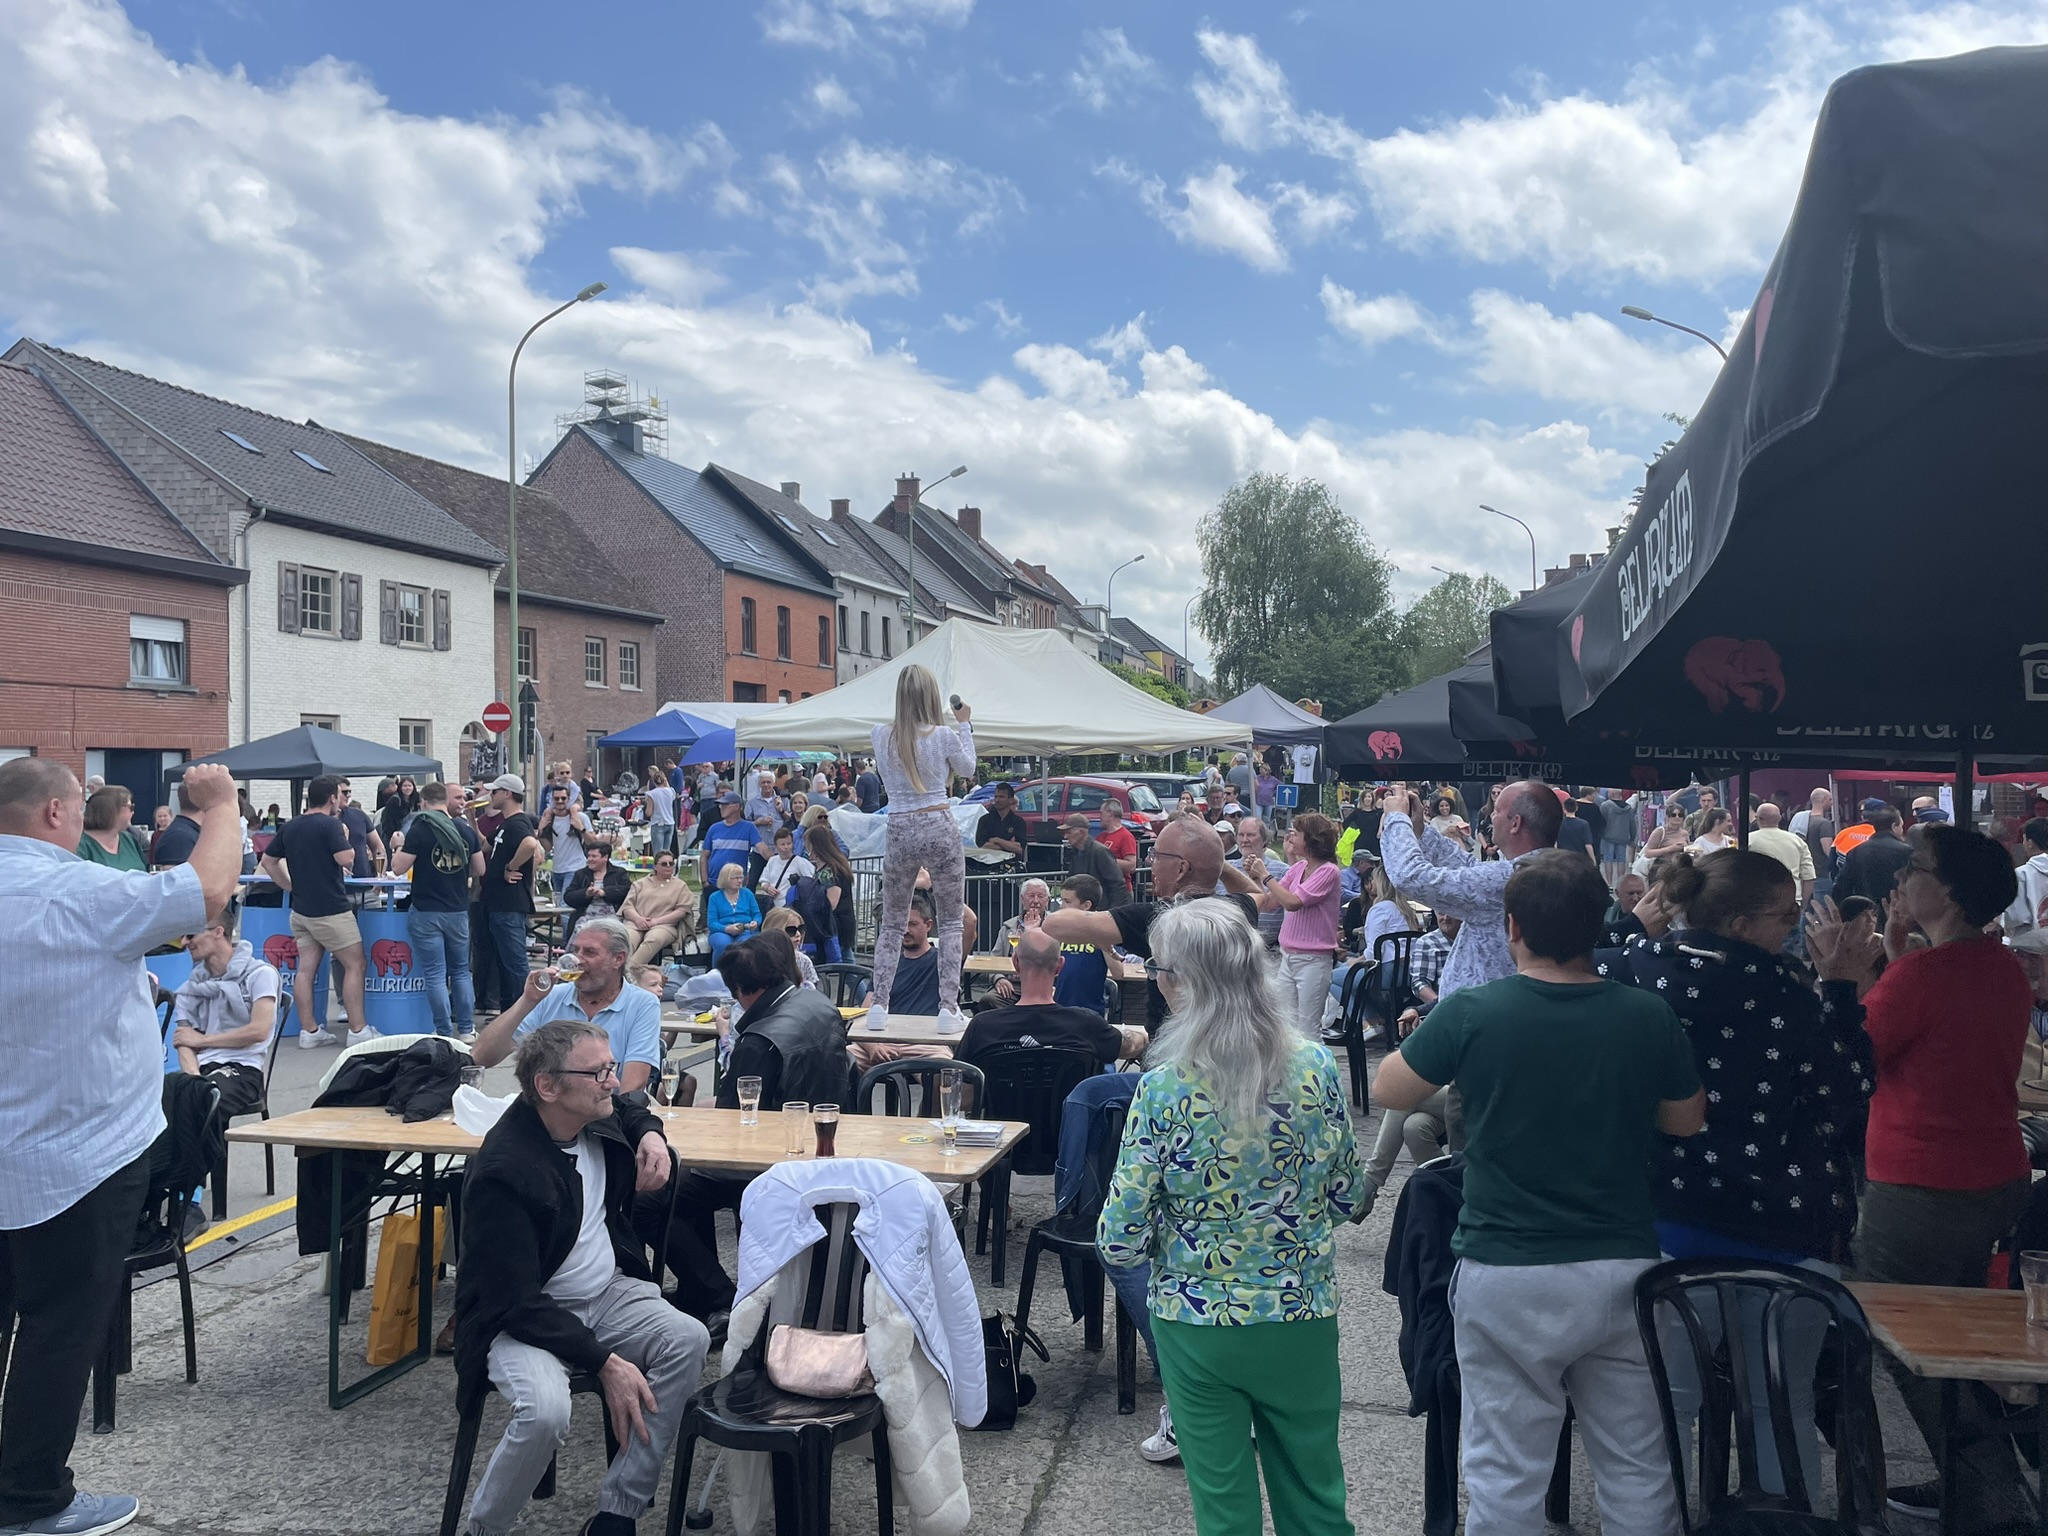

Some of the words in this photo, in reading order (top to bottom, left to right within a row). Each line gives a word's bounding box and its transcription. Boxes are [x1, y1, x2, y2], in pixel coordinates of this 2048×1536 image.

[1618, 469, 1694, 641] DELIRIUM
[1462, 762, 1562, 779] DELIRUM
[364, 977, 426, 992] ELIRIUM
